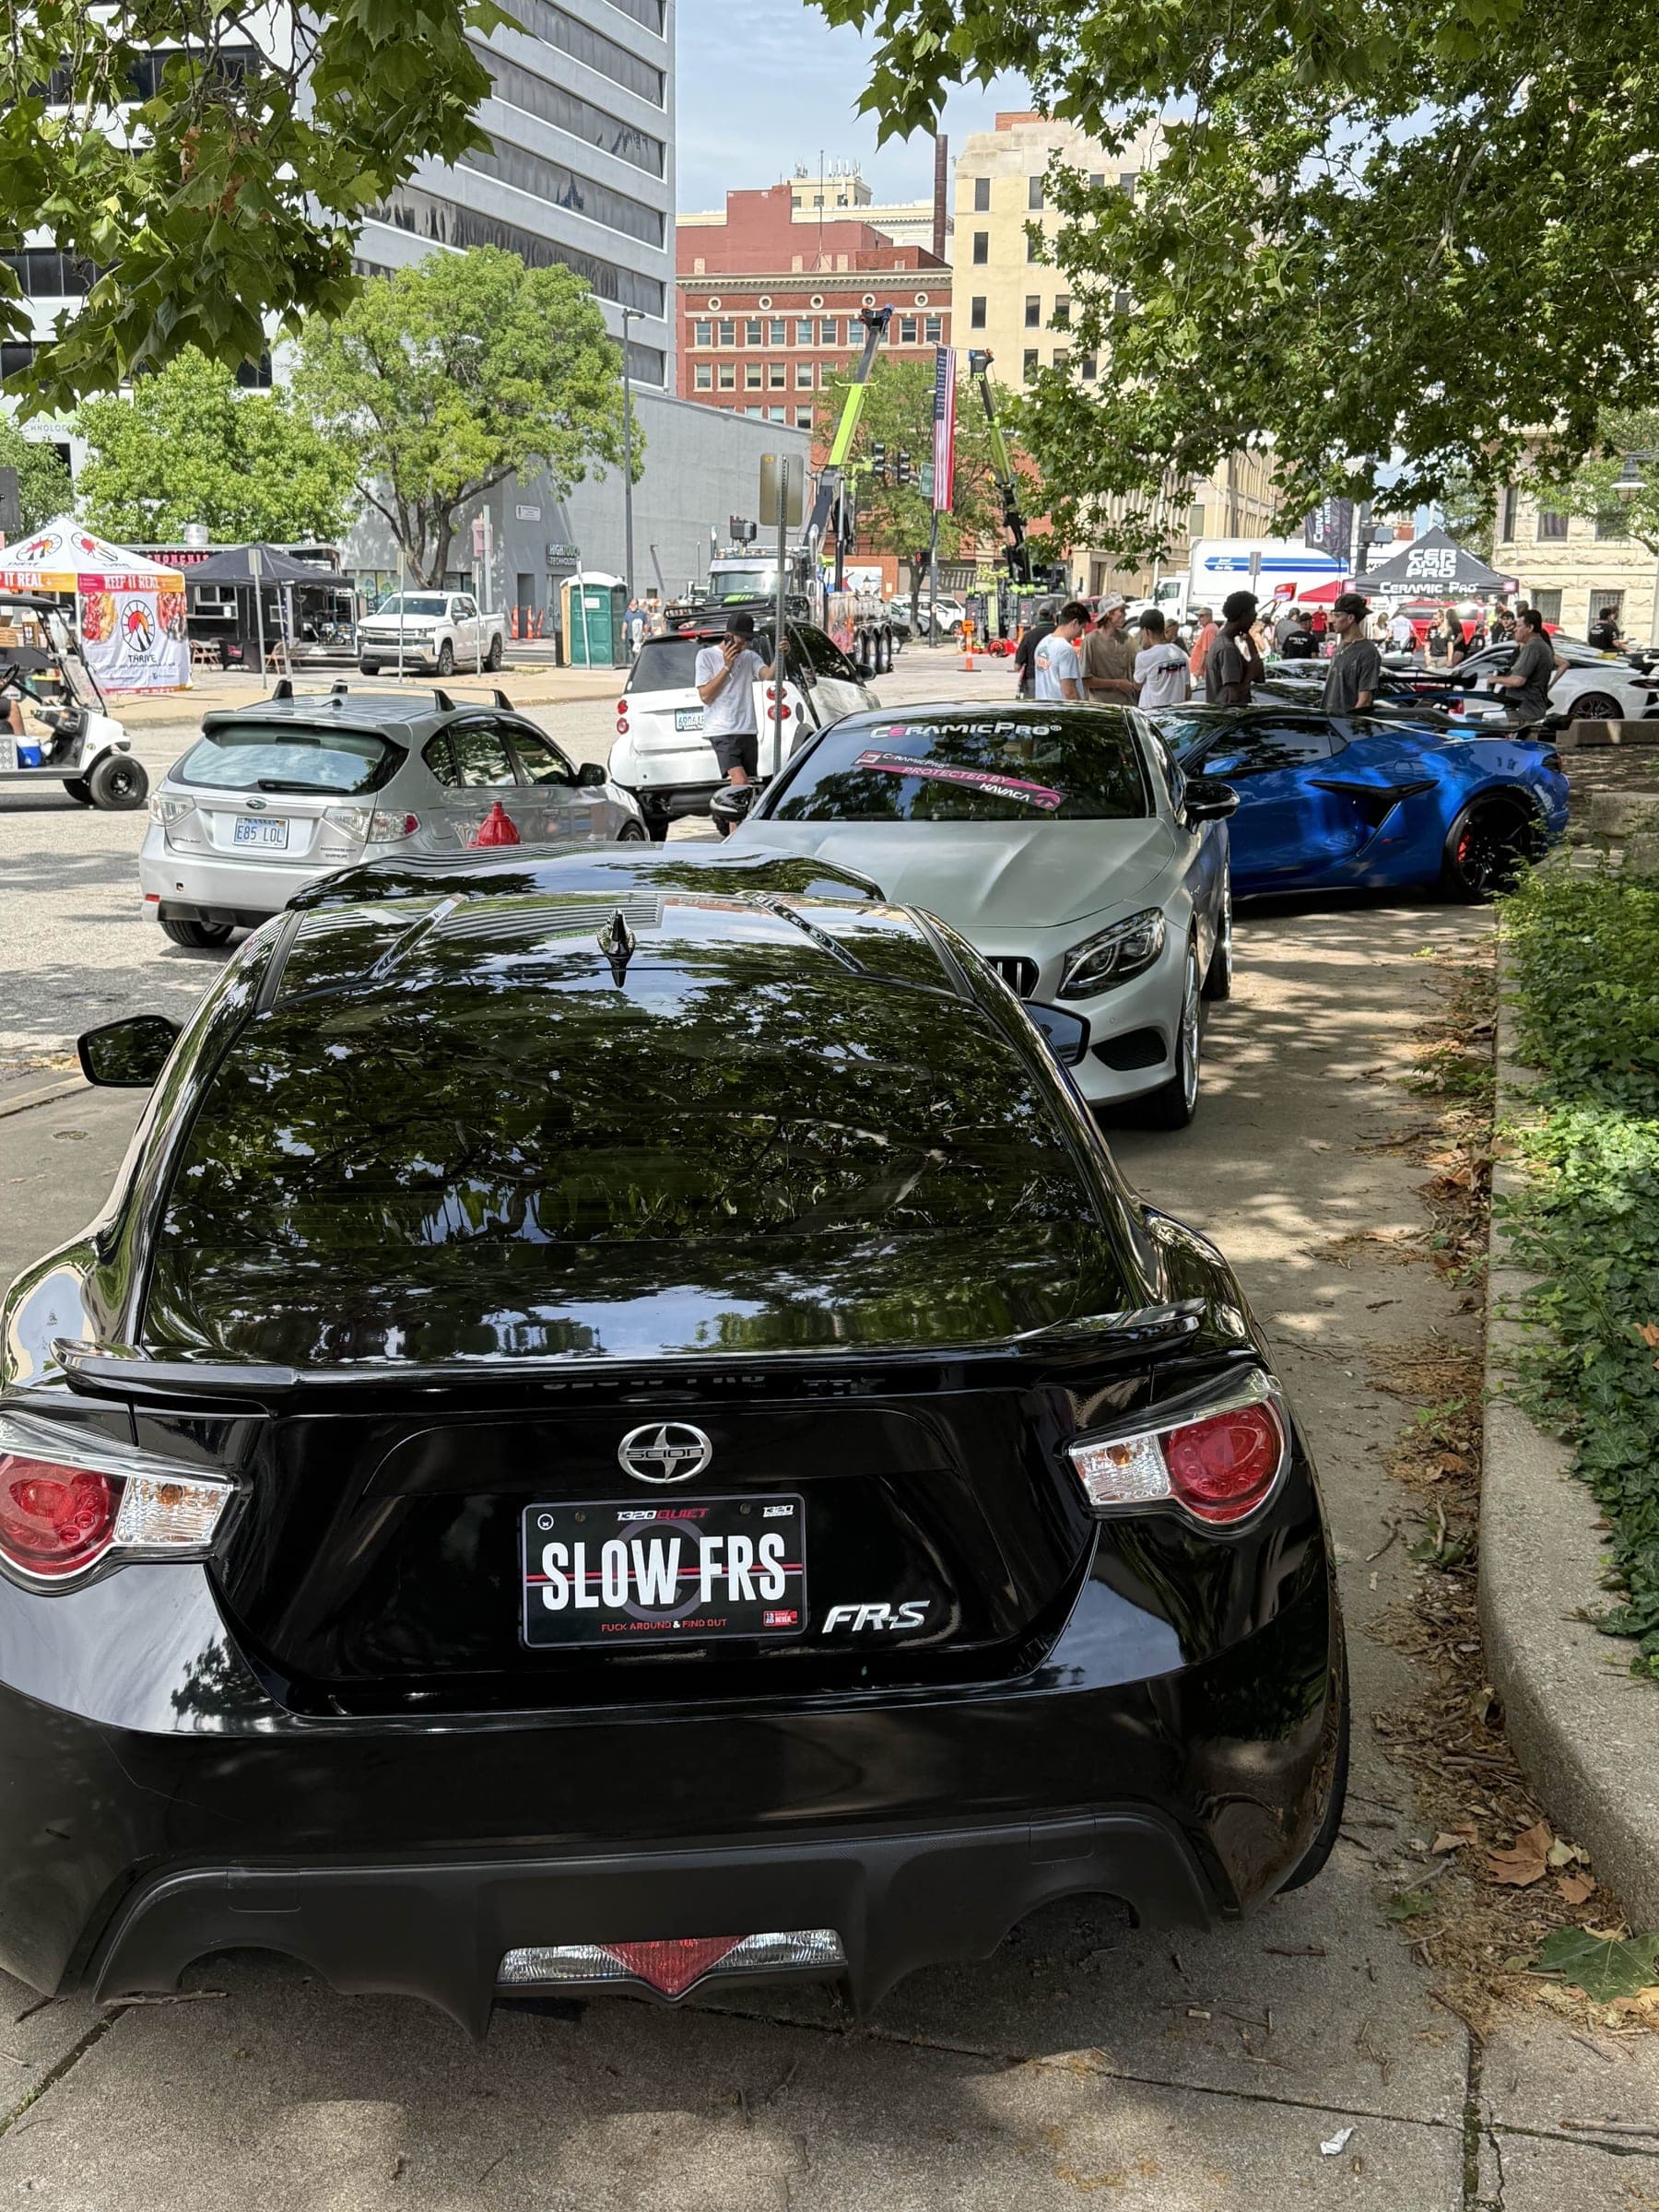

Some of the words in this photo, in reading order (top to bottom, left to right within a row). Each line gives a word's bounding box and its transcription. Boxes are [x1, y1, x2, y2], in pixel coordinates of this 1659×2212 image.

[1408, 548, 1457, 561] CER
[1408, 560, 1456, 569] AMIC
[5, 572, 15, 586] IT
[17, 573, 43, 587] REAL
[1406, 568, 1455, 578] PRO
[103, 575, 125, 589] KEEP
[126, 575, 137, 589] IT
[139, 575, 159, 589] REAL
[1380, 582, 1443, 594] CERAMIC
[904, 766, 988, 781] PROTECTED
[990, 773, 1013, 784] BY
[979, 782, 1030, 802] KAVACA
[237, 826, 258, 841] E85
[542, 1537, 681, 1610] SLOW
[700, 1533, 785, 1603] FRS
[601, 1623, 627, 1631] FUCK
[629, 1621, 671, 1630] AROUND
[673, 1620, 680, 1629] &
[682, 1619, 705, 1629] FIND
[707, 1618, 727, 1628] OUT
